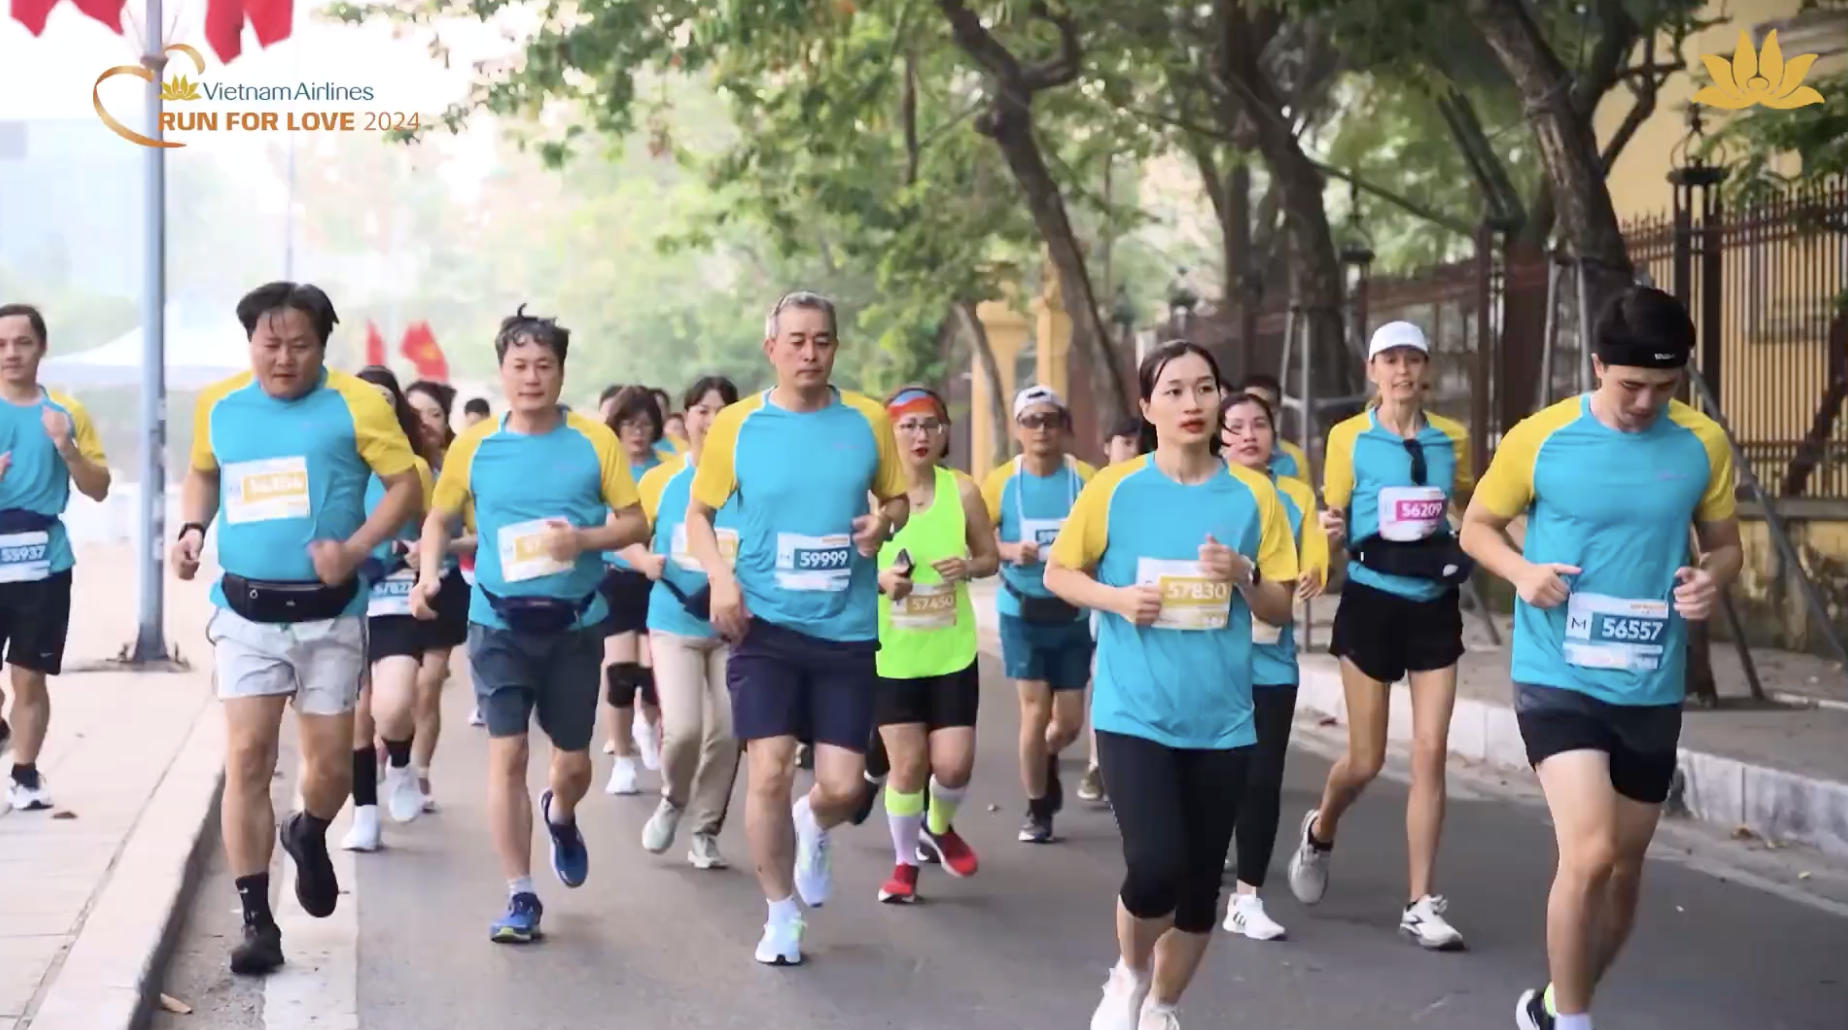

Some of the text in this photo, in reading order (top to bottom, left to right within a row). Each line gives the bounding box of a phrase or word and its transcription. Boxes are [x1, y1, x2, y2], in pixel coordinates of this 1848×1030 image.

[1402, 502, 1443, 518] 56209
[799, 549, 848, 568] 59999
[1167, 582, 1227, 600] 57830
[1571, 616, 1664, 641] M 56557
